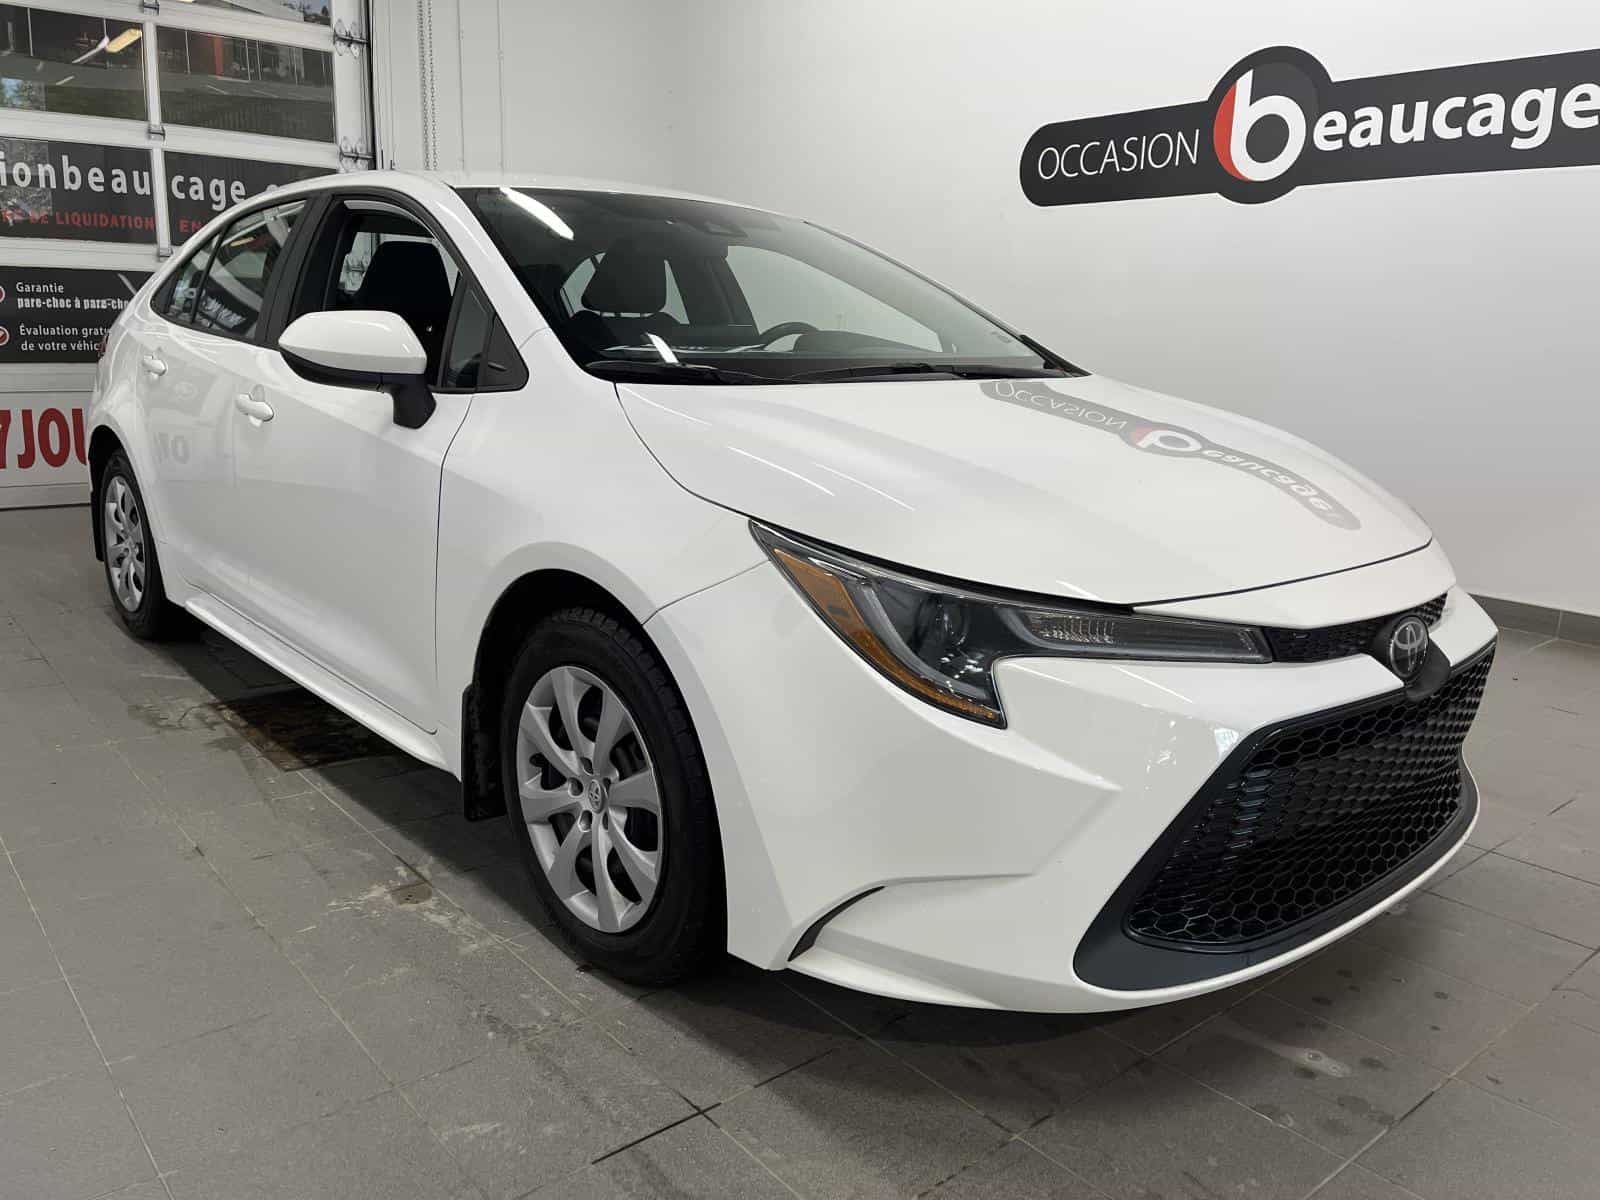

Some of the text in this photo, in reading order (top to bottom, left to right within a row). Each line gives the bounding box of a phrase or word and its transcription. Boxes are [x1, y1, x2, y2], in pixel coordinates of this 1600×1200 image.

[1037, 128, 1200, 180] OCCASION
[55, 211, 157, 233] LIQUIDATION
[16, 282, 64, 293] Garantie
[17, 296, 72, 309] pare-choc
[19, 323, 79, 336] Évaluation
[20, 341, 35, 351] de
[38, 342, 68, 351] votre
